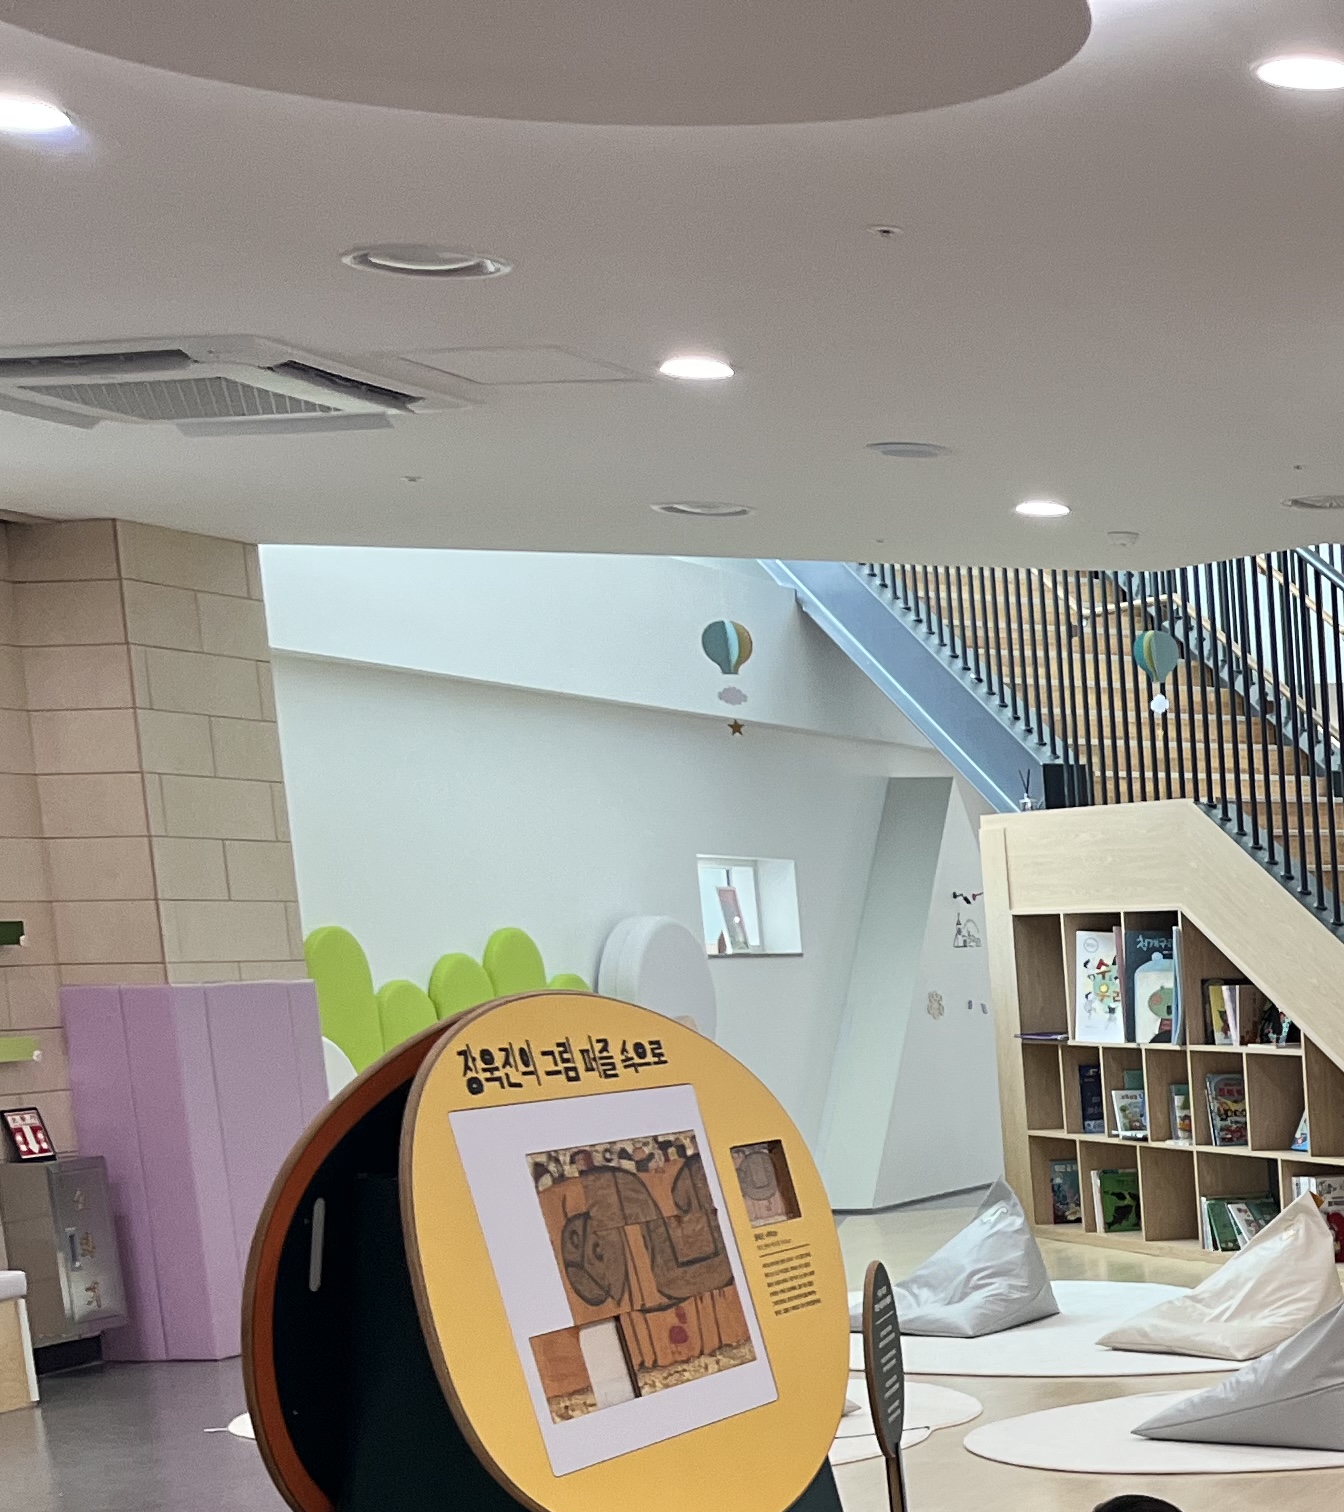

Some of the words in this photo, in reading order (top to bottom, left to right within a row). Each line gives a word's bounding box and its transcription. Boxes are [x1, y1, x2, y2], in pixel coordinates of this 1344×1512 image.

[456, 1039, 542, 1096] 장욱진의
[540, 1036, 582, 1082] 그림
[578, 1034, 620, 1080] 퍼즐
[620, 1038, 669, 1074] 속으로
